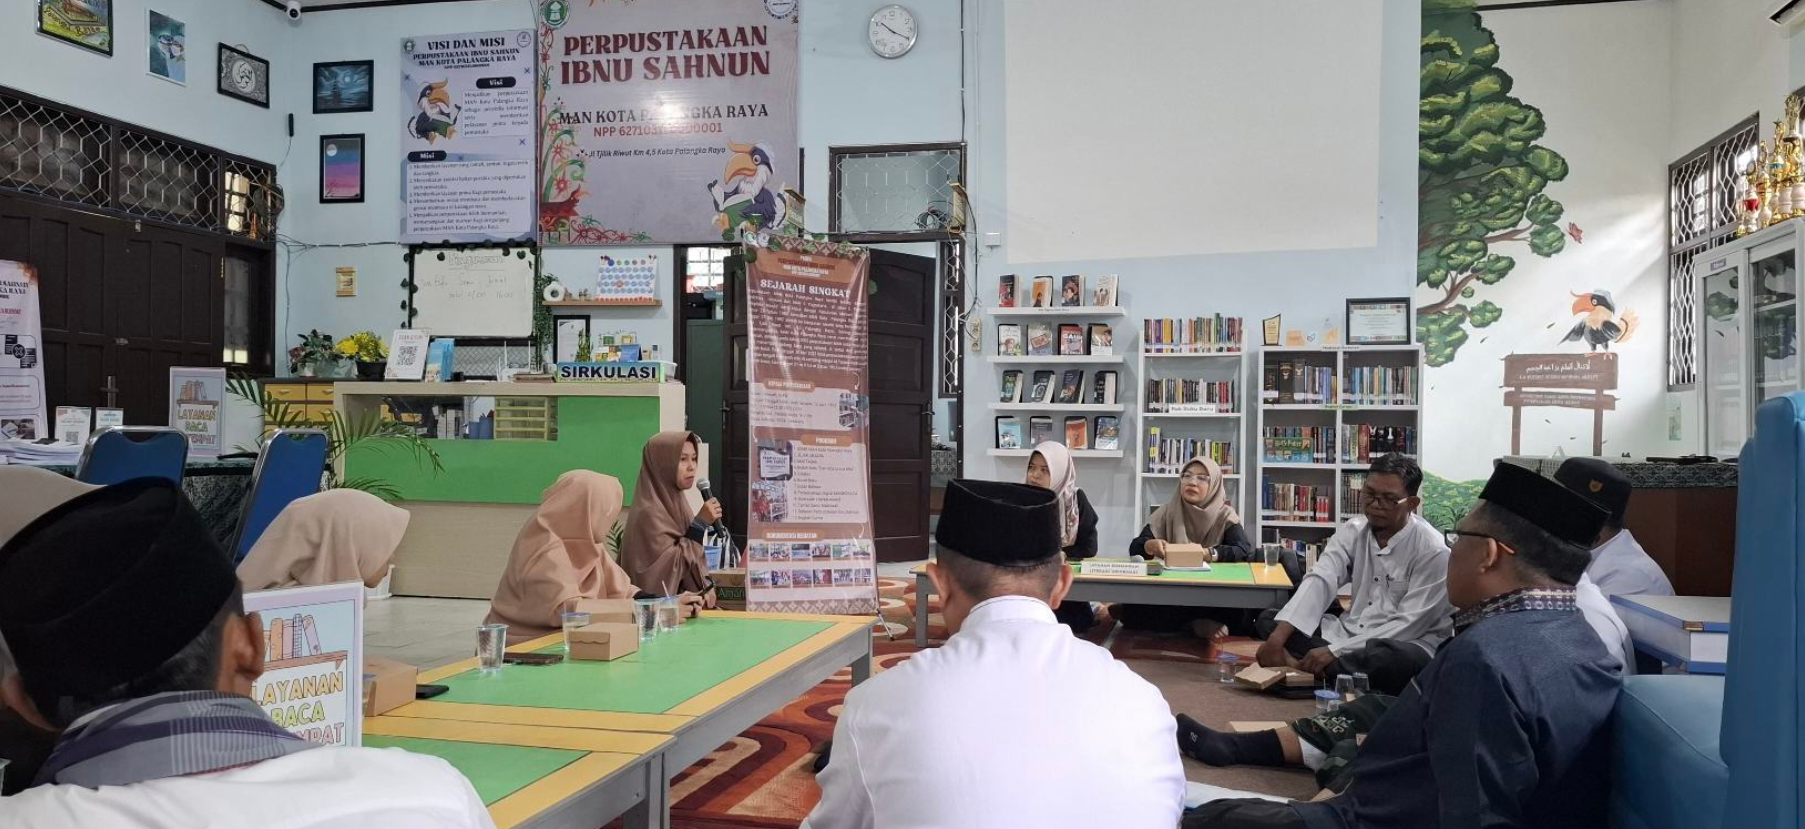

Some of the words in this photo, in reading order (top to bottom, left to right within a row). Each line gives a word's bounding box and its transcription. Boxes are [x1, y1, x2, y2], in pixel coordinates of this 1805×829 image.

[428, 40, 450, 50] VISI
[453, 39, 476, 48] DAN
[480, 37, 505, 47] MISI
[564, 25, 768, 56] PERPUSTAKAAN
[413, 51, 468, 60] PERPUSTAKAAN
[458, 56, 495, 64] PALANGKA
[561, 58, 634, 84] IBNU
[643, 51, 770, 80] SAHNUN
[559, 111, 592, 125] MAN
[596, 109, 636, 123] KOTA
[726, 104, 769, 118] RAYA
[594, 126, 616, 137] NPP
[657, 148, 674, 156] Kota
[708, 146, 726, 154] Raya
[760, 279, 806, 294] SEJARAH
[808, 285, 852, 298] SINGKAT
[561, 366, 656, 378] SIRKULASI
[178, 409, 216, 421] LAYANAN
[185, 421, 208, 432] BACA
[271, 700, 326, 728] BACA
